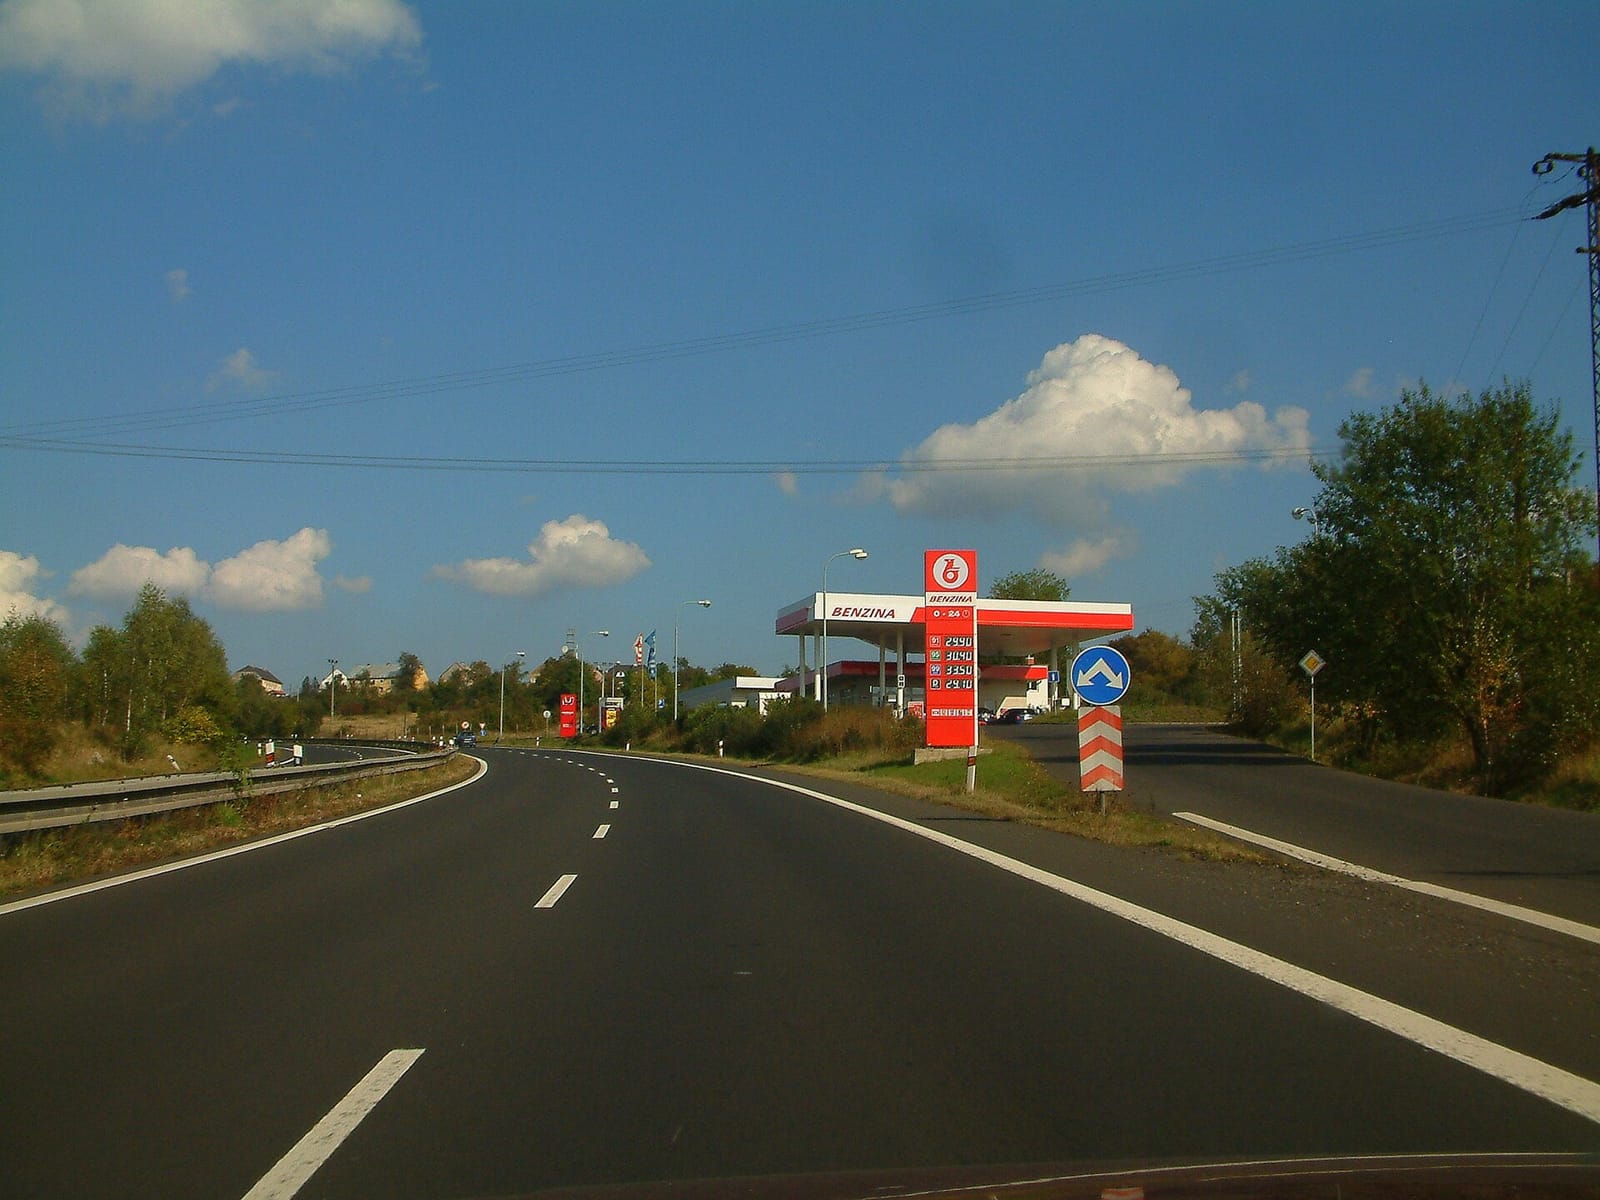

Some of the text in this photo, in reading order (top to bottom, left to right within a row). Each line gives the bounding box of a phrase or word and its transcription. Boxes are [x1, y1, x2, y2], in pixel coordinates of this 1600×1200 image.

[929, 595, 973, 603] BENZINA
[831, 607, 896, 619] BENZINA
[948, 610, 961, 618] 24
